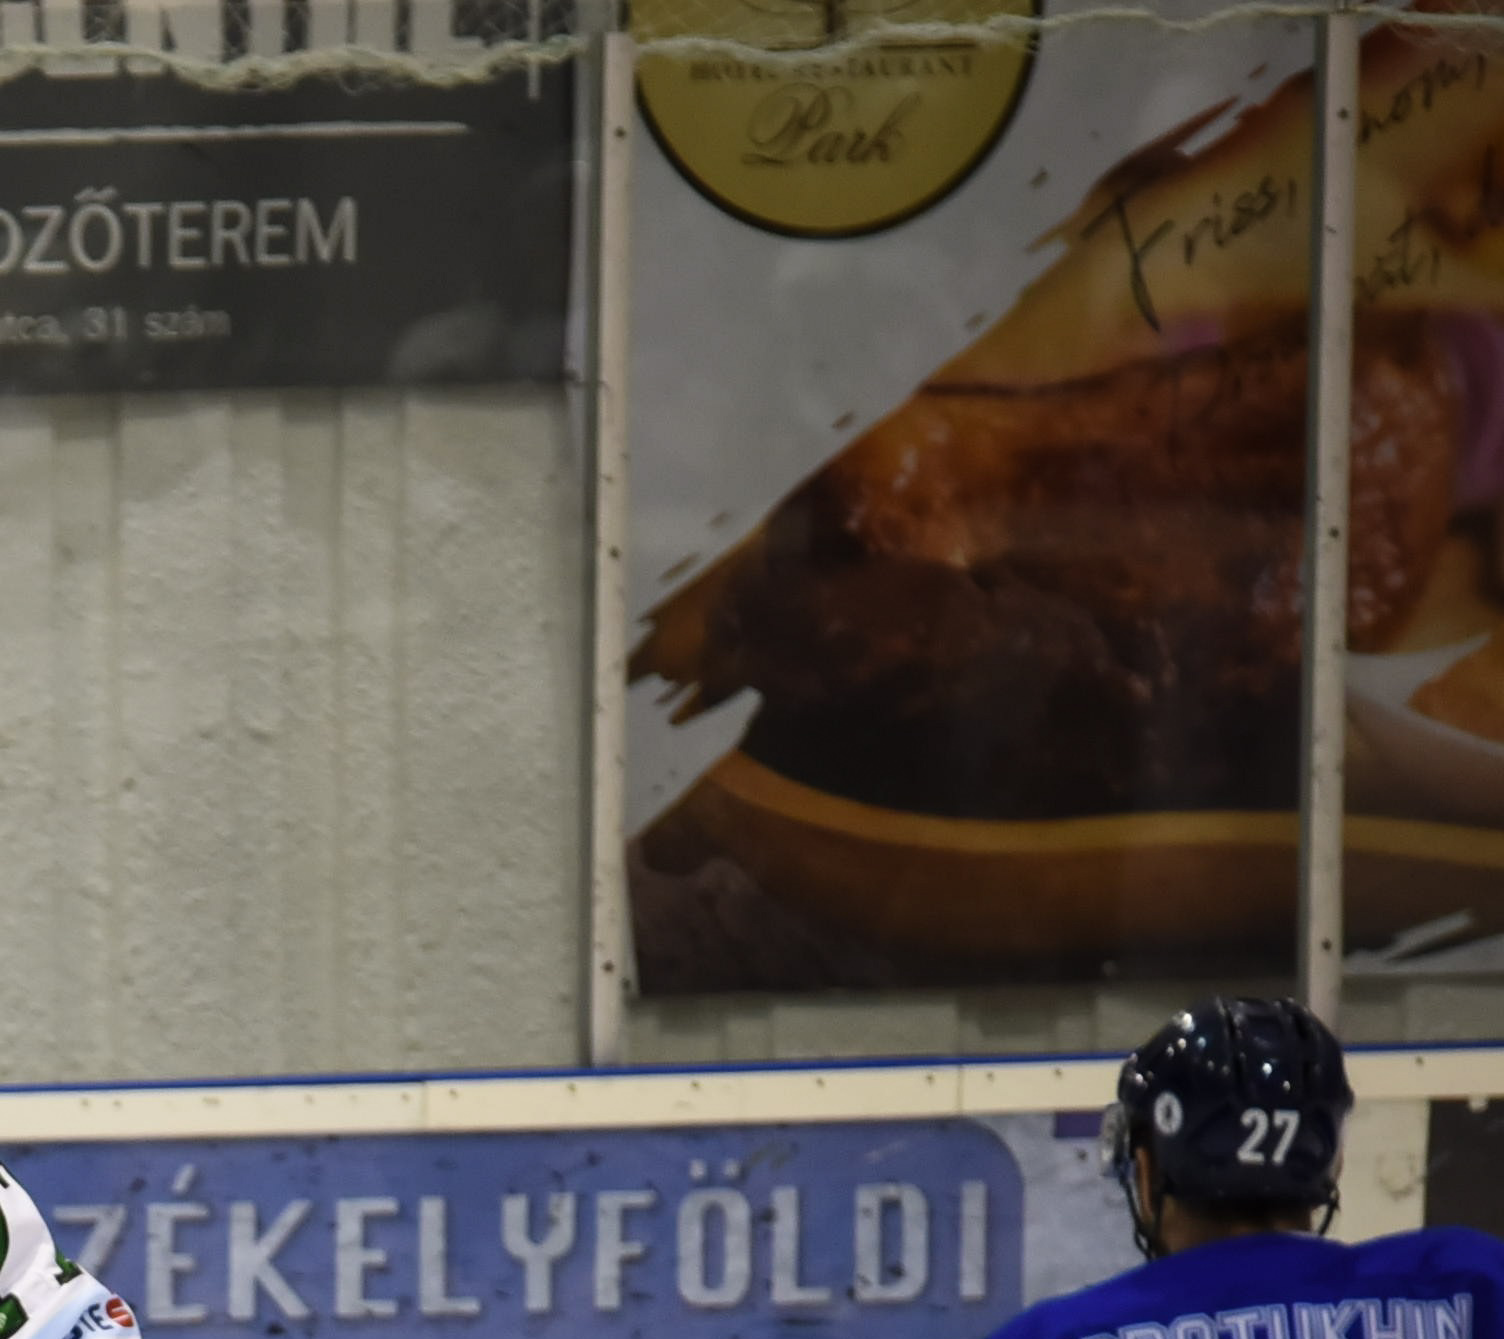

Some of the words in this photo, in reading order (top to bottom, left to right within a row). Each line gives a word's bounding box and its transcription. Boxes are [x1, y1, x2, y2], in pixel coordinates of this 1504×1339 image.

[741, 82, 921, 167] Park
[1236, 1107, 1302, 1164] 27
[53, 1160, 988, 1326] ZÉKELYFÖLDI
